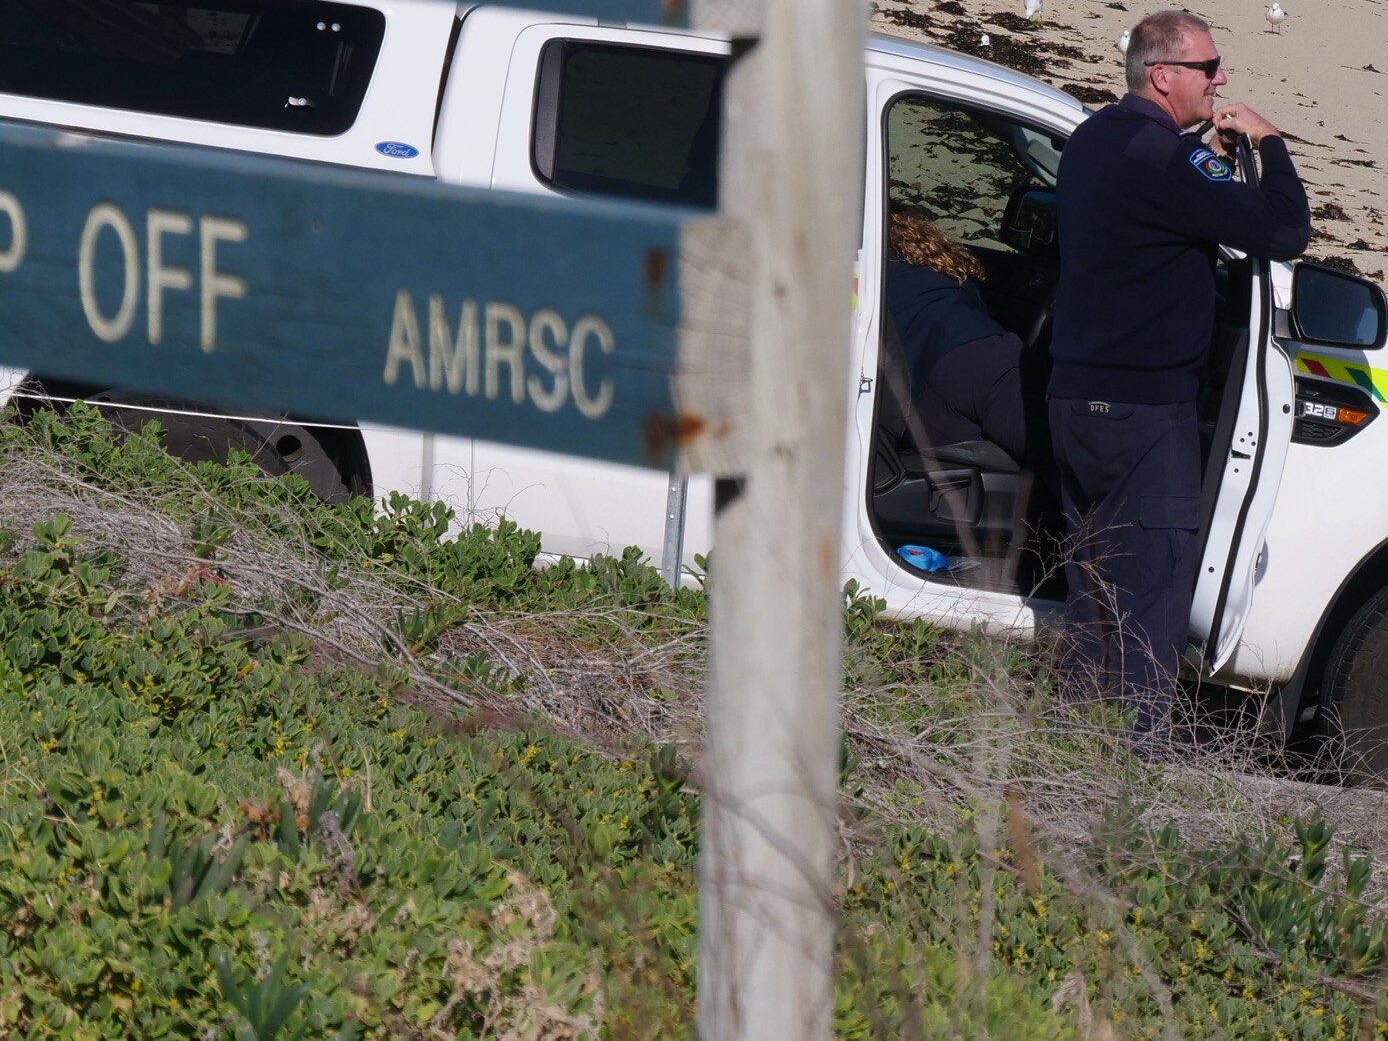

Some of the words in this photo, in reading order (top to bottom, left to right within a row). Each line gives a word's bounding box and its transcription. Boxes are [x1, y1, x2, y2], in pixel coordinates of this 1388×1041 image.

[383, 143, 411, 158] Ford
[78, 203, 248, 352] OFF
[383, 290, 615, 418] AMRSC
